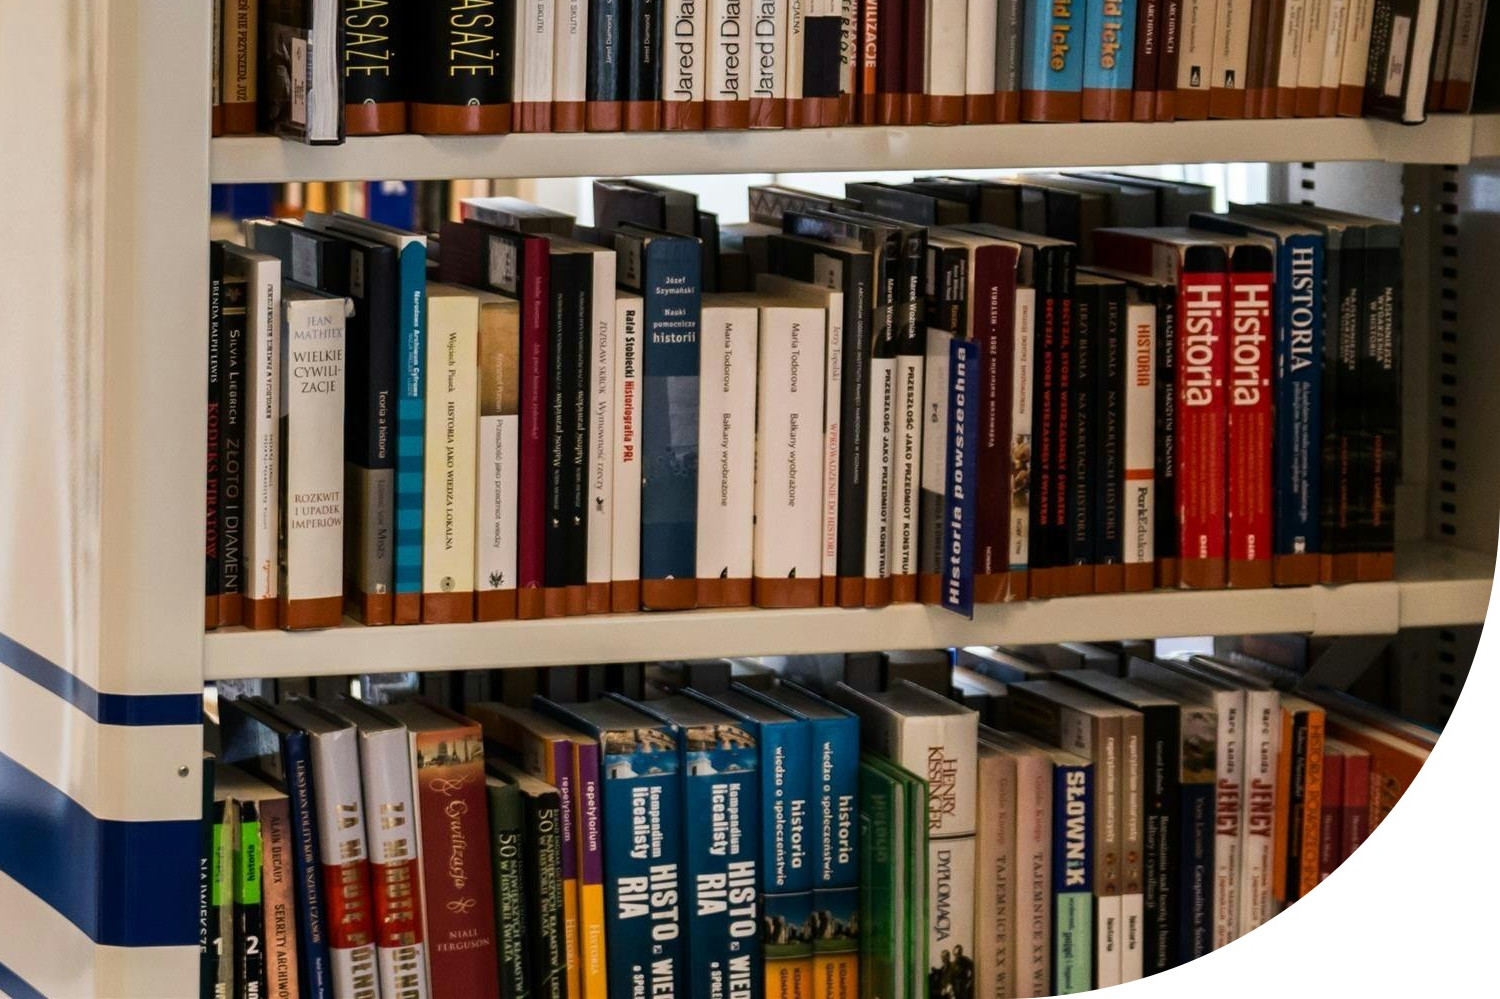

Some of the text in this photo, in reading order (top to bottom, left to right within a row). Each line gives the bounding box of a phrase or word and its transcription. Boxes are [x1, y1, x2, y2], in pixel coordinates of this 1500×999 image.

[674, 42, 700, 103] Jared
[720, 42, 744, 102] Jared
[754, 41, 779, 100] Jared
[1050, 24, 1070, 73] Icke
[1100, 22, 1122, 69] Icke
[209, 279, 220, 384] BRENDA RALPH LEWIS
[652, 332, 697, 343] historii
[907, 275, 919, 339] Marek Woźniak
[1289, 246, 1315, 372] HISTORIA
[227, 328, 241, 425] SILVIA LIEBRICH
[293, 350, 343, 363] WIELKIE
[294, 365, 342, 379] CYWILI-
[446, 331, 458, 393] Wojciech Piasek
[623, 309, 636, 379] Rafał Stobiecki
[722, 322, 733, 393] Maria Todorova
[789, 322, 800, 393] Maria Todorova
[1136, 323, 1152, 387] HISTORIA
[1186, 283, 1222, 406] Historia
[1233, 282, 1270, 406] Historia
[301, 381, 336, 394] ZACJE
[622, 380, 635, 463] Historiografia PRL
[905, 365, 917, 431] PRZESZŁOŚĆ
[444, 400, 456, 551] HISTORIA JAKO WIEDZA LOKALNA
[719, 412, 732, 507] Bałkany wyobrażone
[786, 412, 799, 507] Bałkany wyobrażone
[904, 432, 915, 461] JAKO
[949, 346, 967, 604] Historia powszechna
[292, 517, 343, 530] IMPERIÓW
[294, 492, 341, 504] ROZKWIT
[902, 462, 913, 519] PRZEDMIOT
[538, 808, 554, 833] 50
[561, 776, 573, 842] repetytorium
[585, 781, 599, 852] repetytorium
[630, 786, 651, 859] licealisty
[650, 785, 664, 859] Kompendium
[708, 784, 729, 857] licealisty
[728, 783, 742, 855] Kompendium
[822, 741, 835, 881] wiedza o społeczeństwie
[928, 745, 945, 831] KISSINGER
[941, 758, 959, 817] HENRY
[444, 799, 469, 889] Cywilizacja
[499, 833, 517, 858] 50
[790, 799, 806, 869] historia
[838, 794, 853, 865] historia
[1064, 769, 1086, 887] SŁOWNiK
[617, 876, 648, 920] RIA
[650, 862, 679, 942] HISTO
[696, 873, 728, 917] RIA
[728, 860, 757, 938] HISTO
[934, 849, 952, 942] DYPLOMACJA
[246, 935, 259, 955] 2
